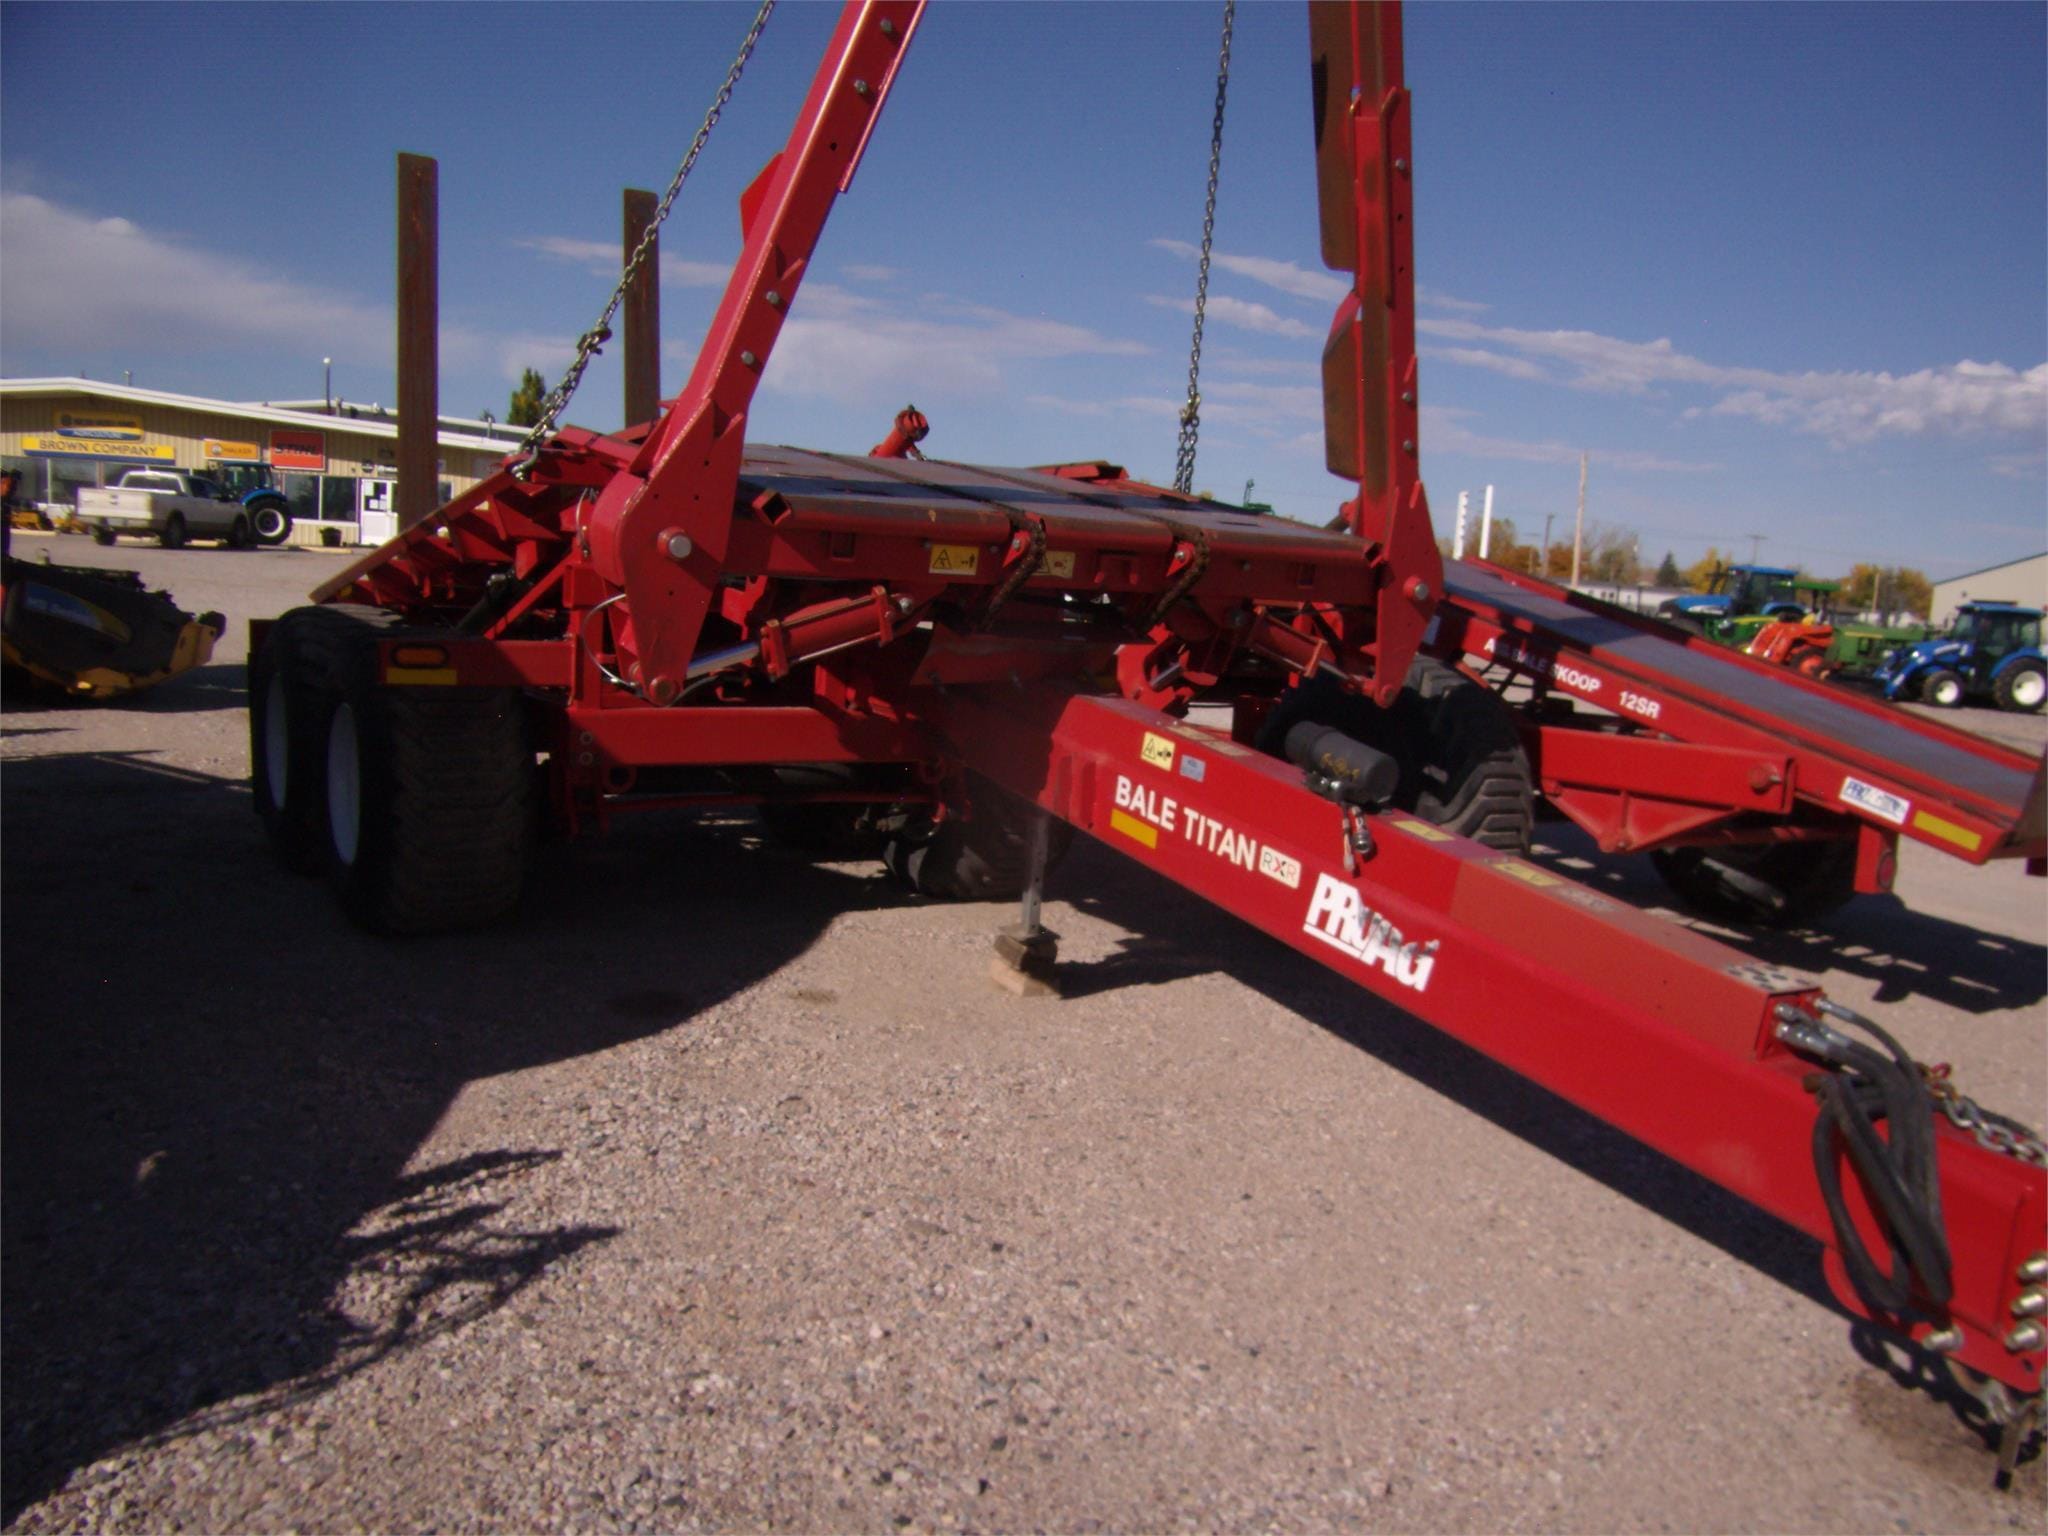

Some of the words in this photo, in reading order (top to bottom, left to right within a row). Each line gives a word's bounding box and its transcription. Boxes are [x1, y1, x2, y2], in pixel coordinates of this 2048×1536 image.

[39, 439, 89, 452] BROWN
[92, 443, 158, 456] COMPANY
[1618, 690, 1661, 719] 12SR
[1115, 775, 1176, 831] BALE
[1184, 808, 1257, 871] TITAN
[1263, 849, 1298, 883] RXR
